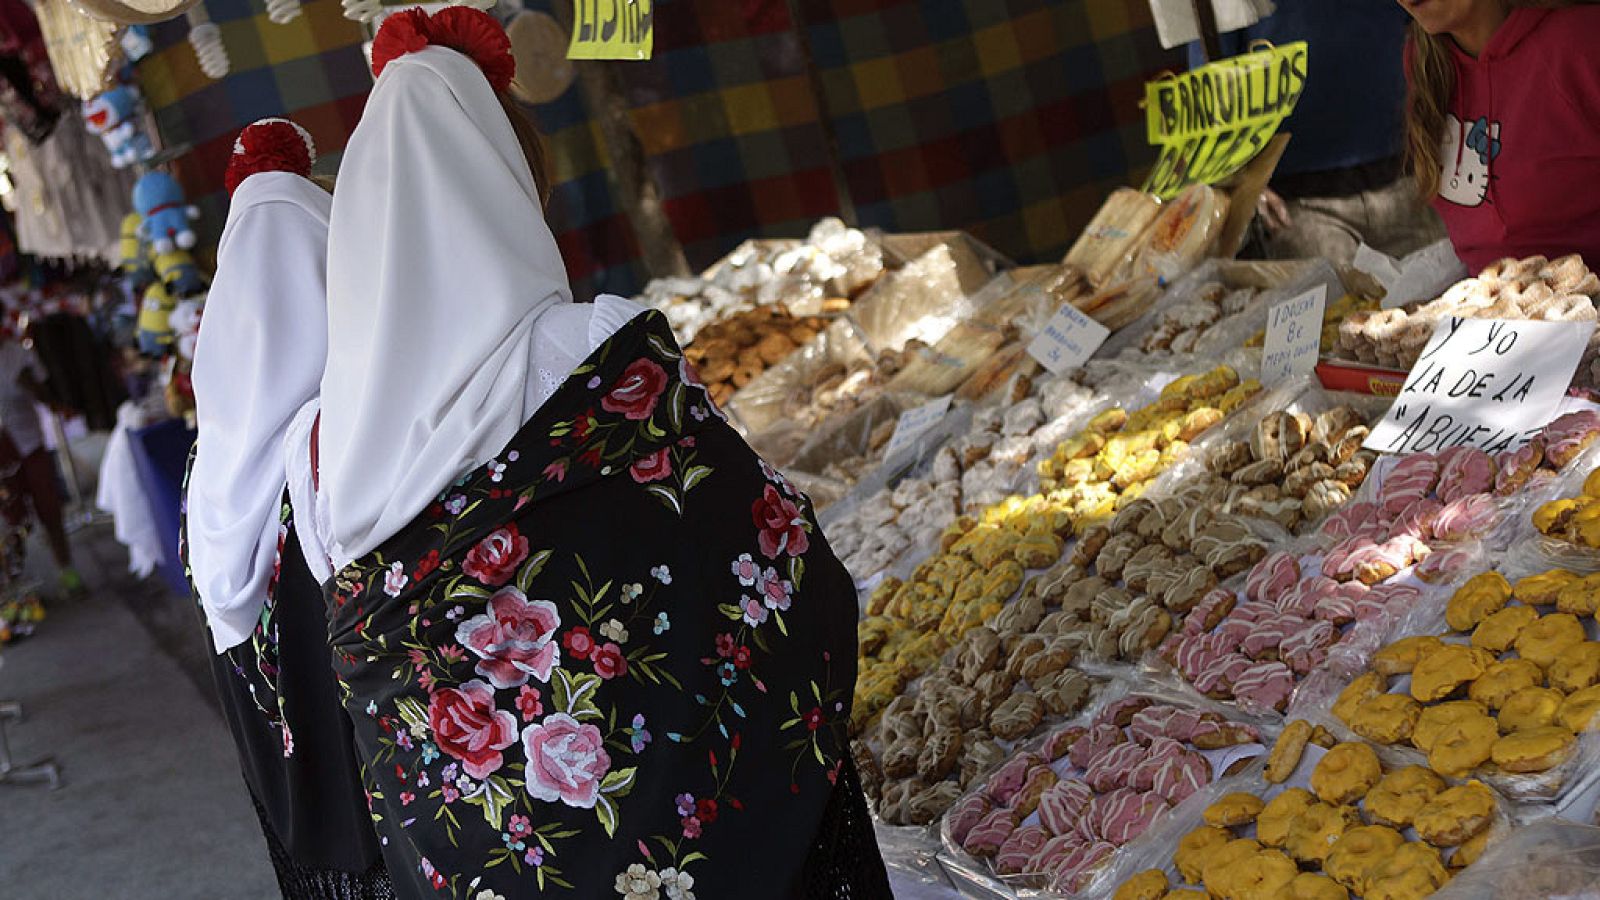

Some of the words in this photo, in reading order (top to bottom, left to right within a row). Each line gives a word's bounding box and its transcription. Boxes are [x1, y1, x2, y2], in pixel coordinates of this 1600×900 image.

[1158, 50, 1307, 137] BARQUILLOS
[1421, 316, 1465, 360] Y
[1467, 321, 1518, 355] YO
[1405, 361, 1446, 394] LA
[1447, 369, 1495, 398] DE
[1491, 372, 1536, 403] LA
